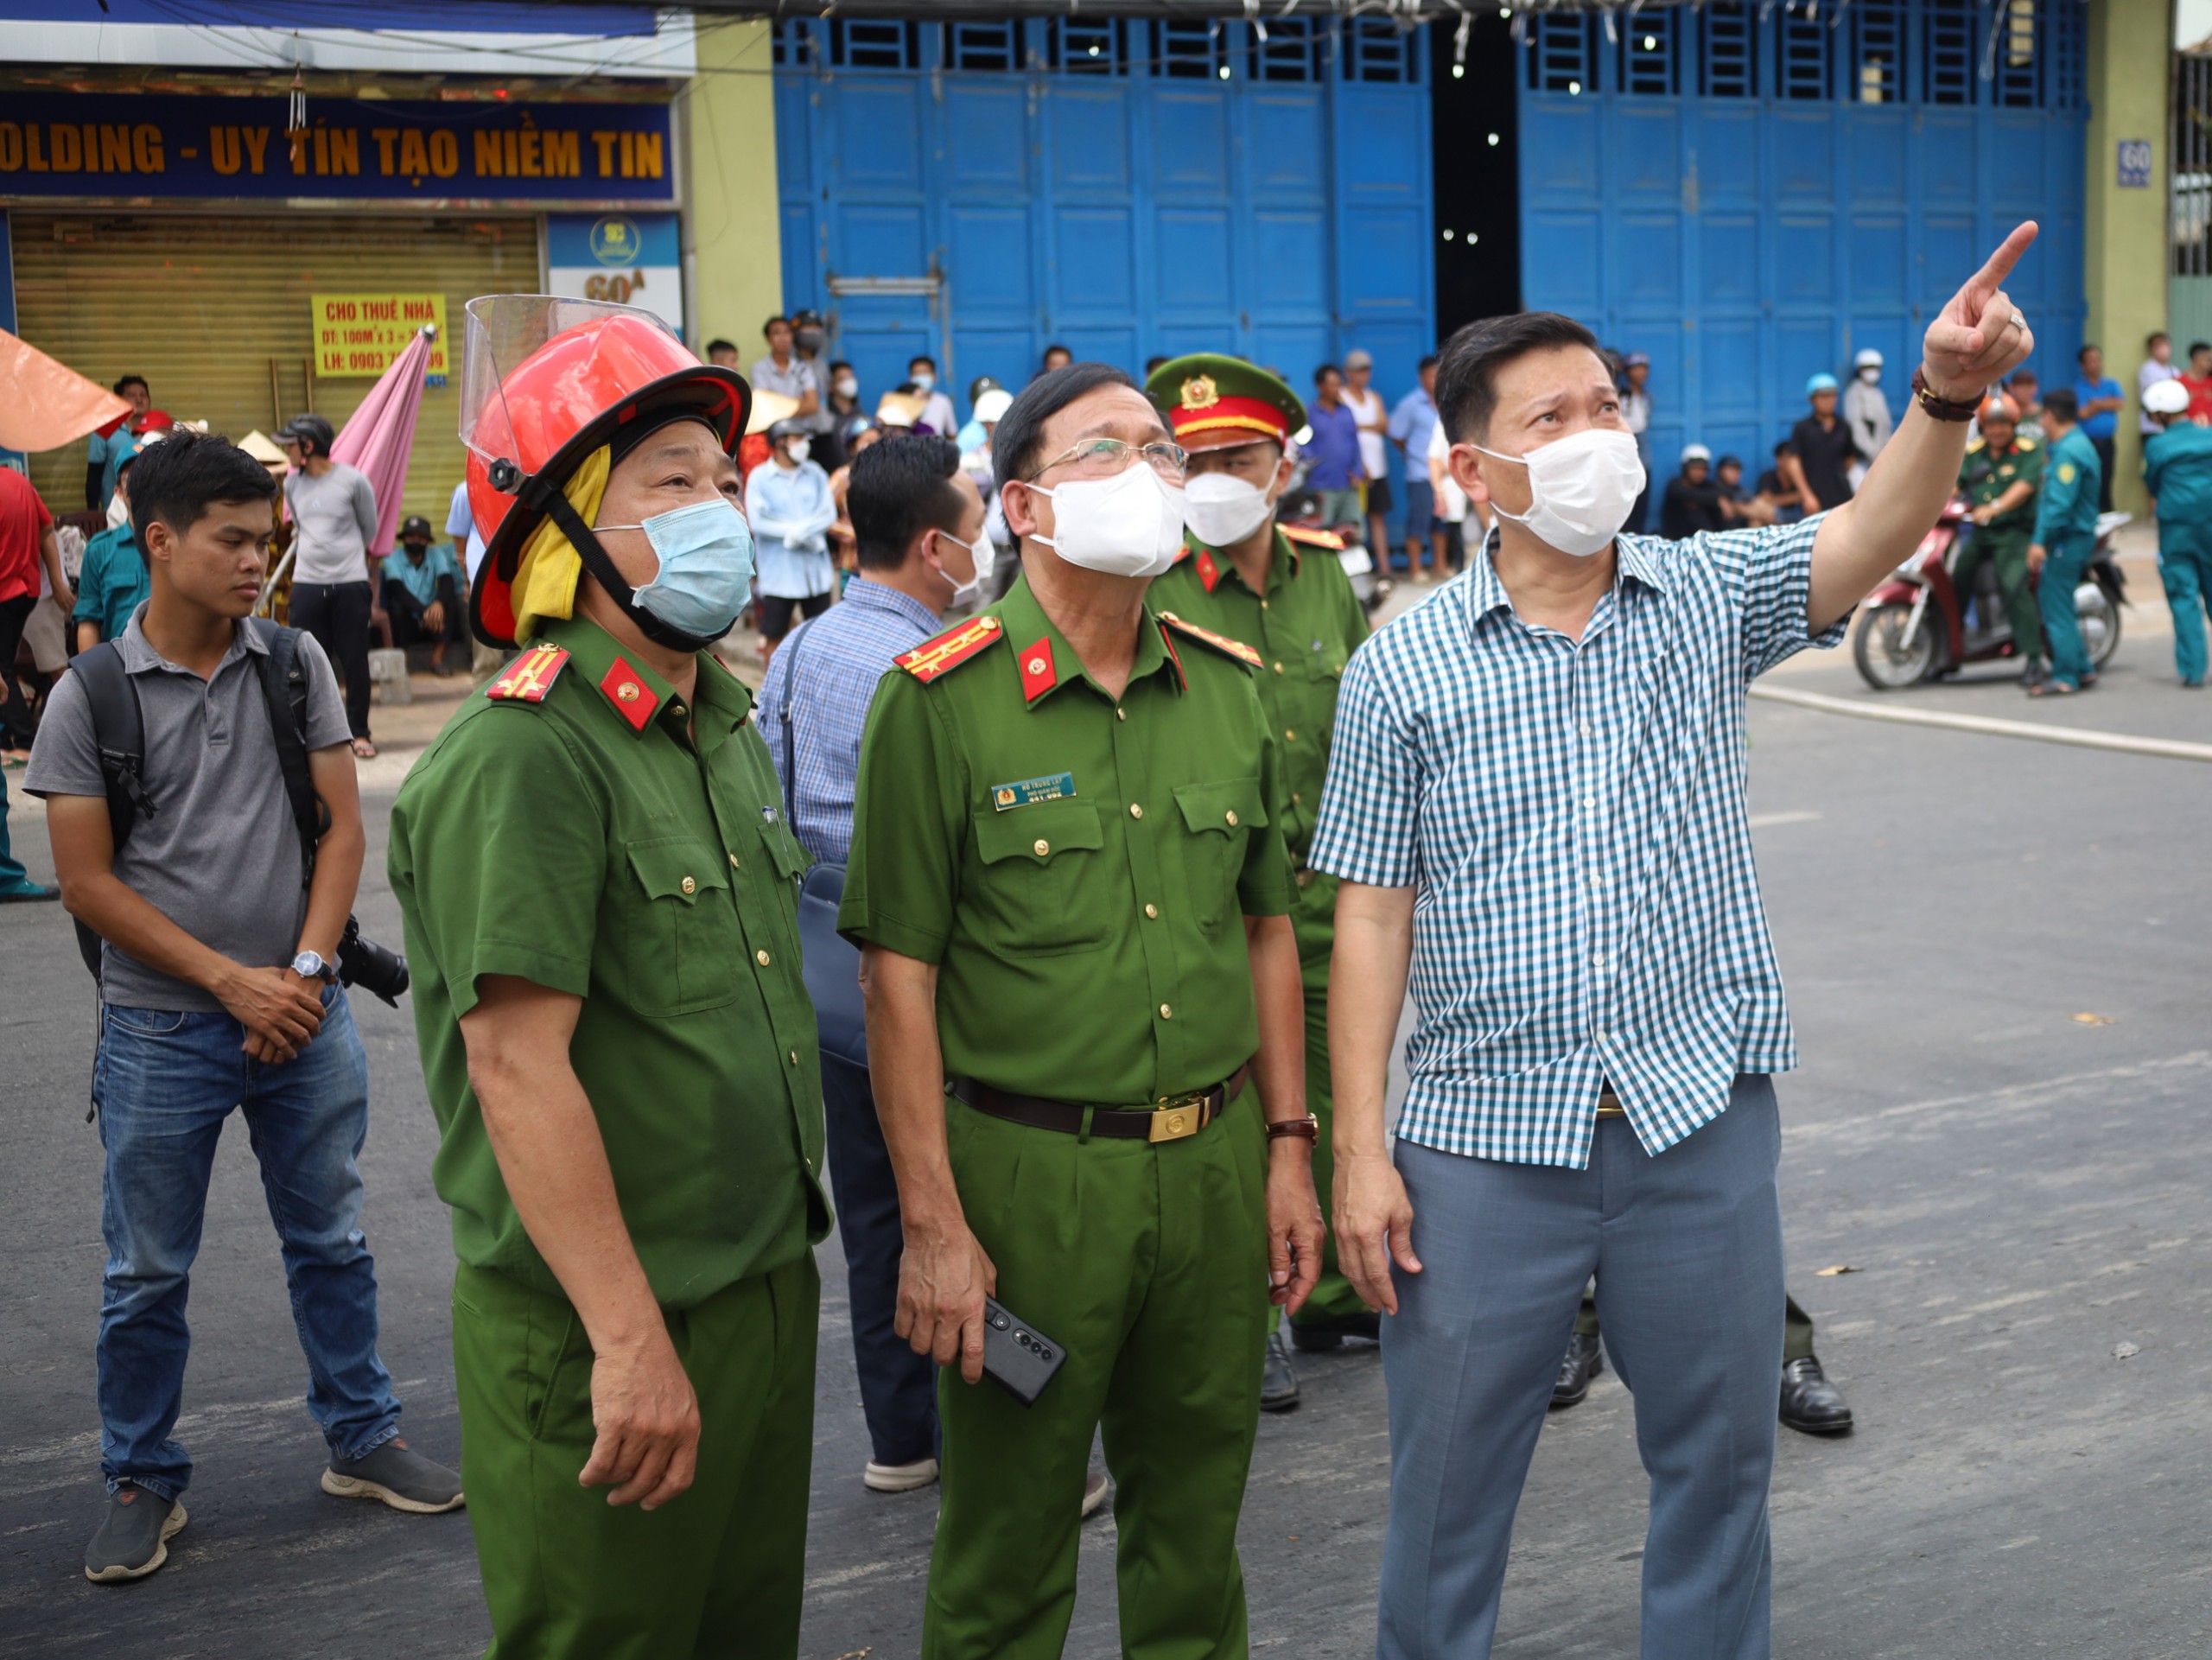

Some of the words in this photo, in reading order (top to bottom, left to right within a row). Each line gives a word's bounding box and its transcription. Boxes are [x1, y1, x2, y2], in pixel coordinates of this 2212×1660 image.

[0, 122, 165, 174] OLDING
[209, 126, 270, 175] UY
[284, 117, 360, 175] TÍN
[372, 128, 459, 188] TẠO
[474, 111, 582, 178] NIỀM
[591, 130, 663, 179] TIN
[327, 302, 356, 321] CHO
[404, 297, 435, 321] NHÀ
[323, 352, 346, 371] LH:
[349, 352, 384, 371] 0903
